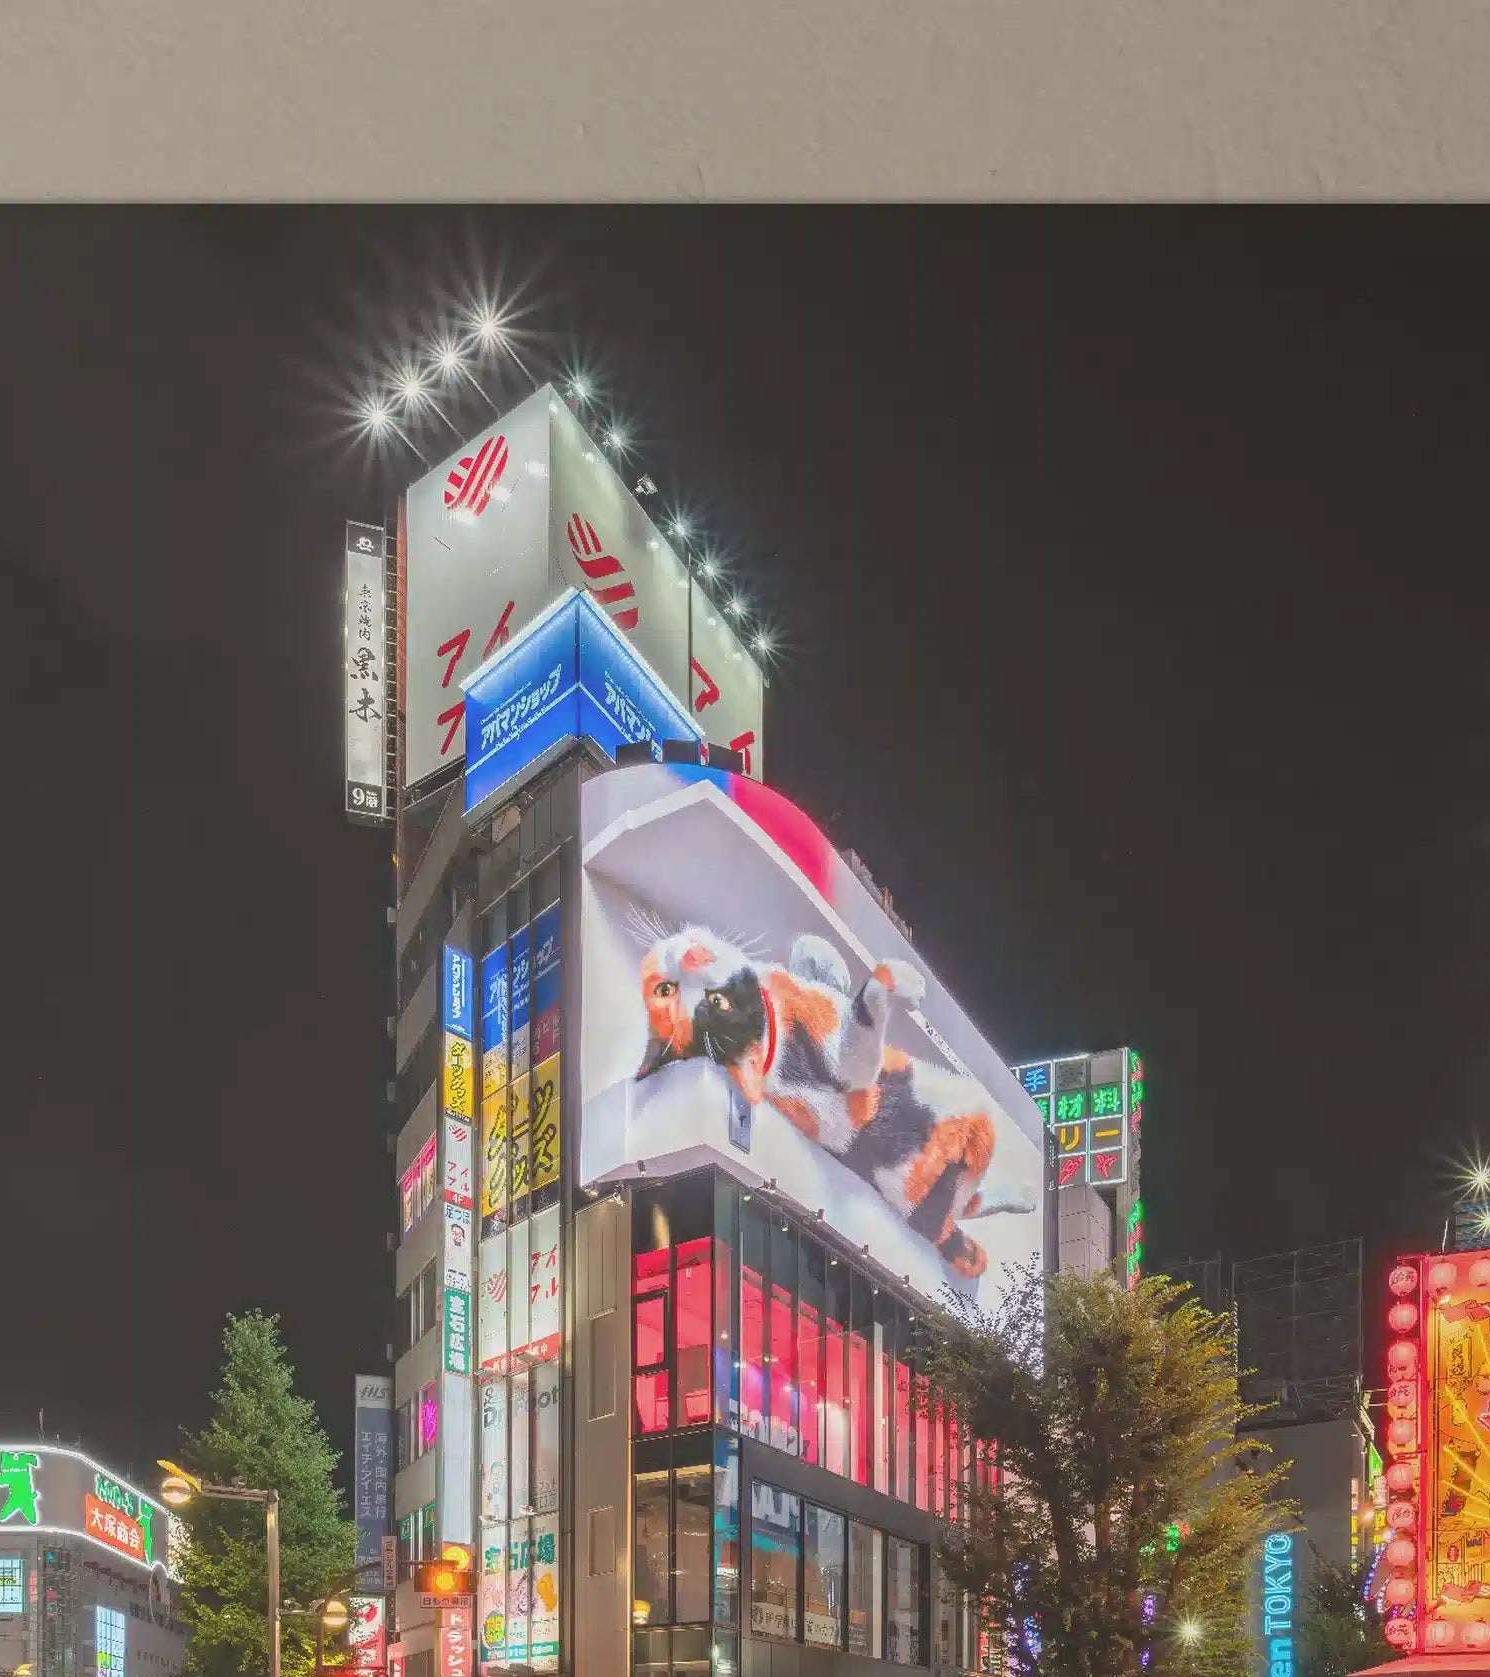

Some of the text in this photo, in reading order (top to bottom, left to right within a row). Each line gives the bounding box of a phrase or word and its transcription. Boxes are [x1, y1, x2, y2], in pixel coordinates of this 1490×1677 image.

[481, 663, 562, 751] アパマンショップ
[91, 1508, 141, 1550] 大塚商会
[1264, 1532, 1293, 1636] TOKYO
